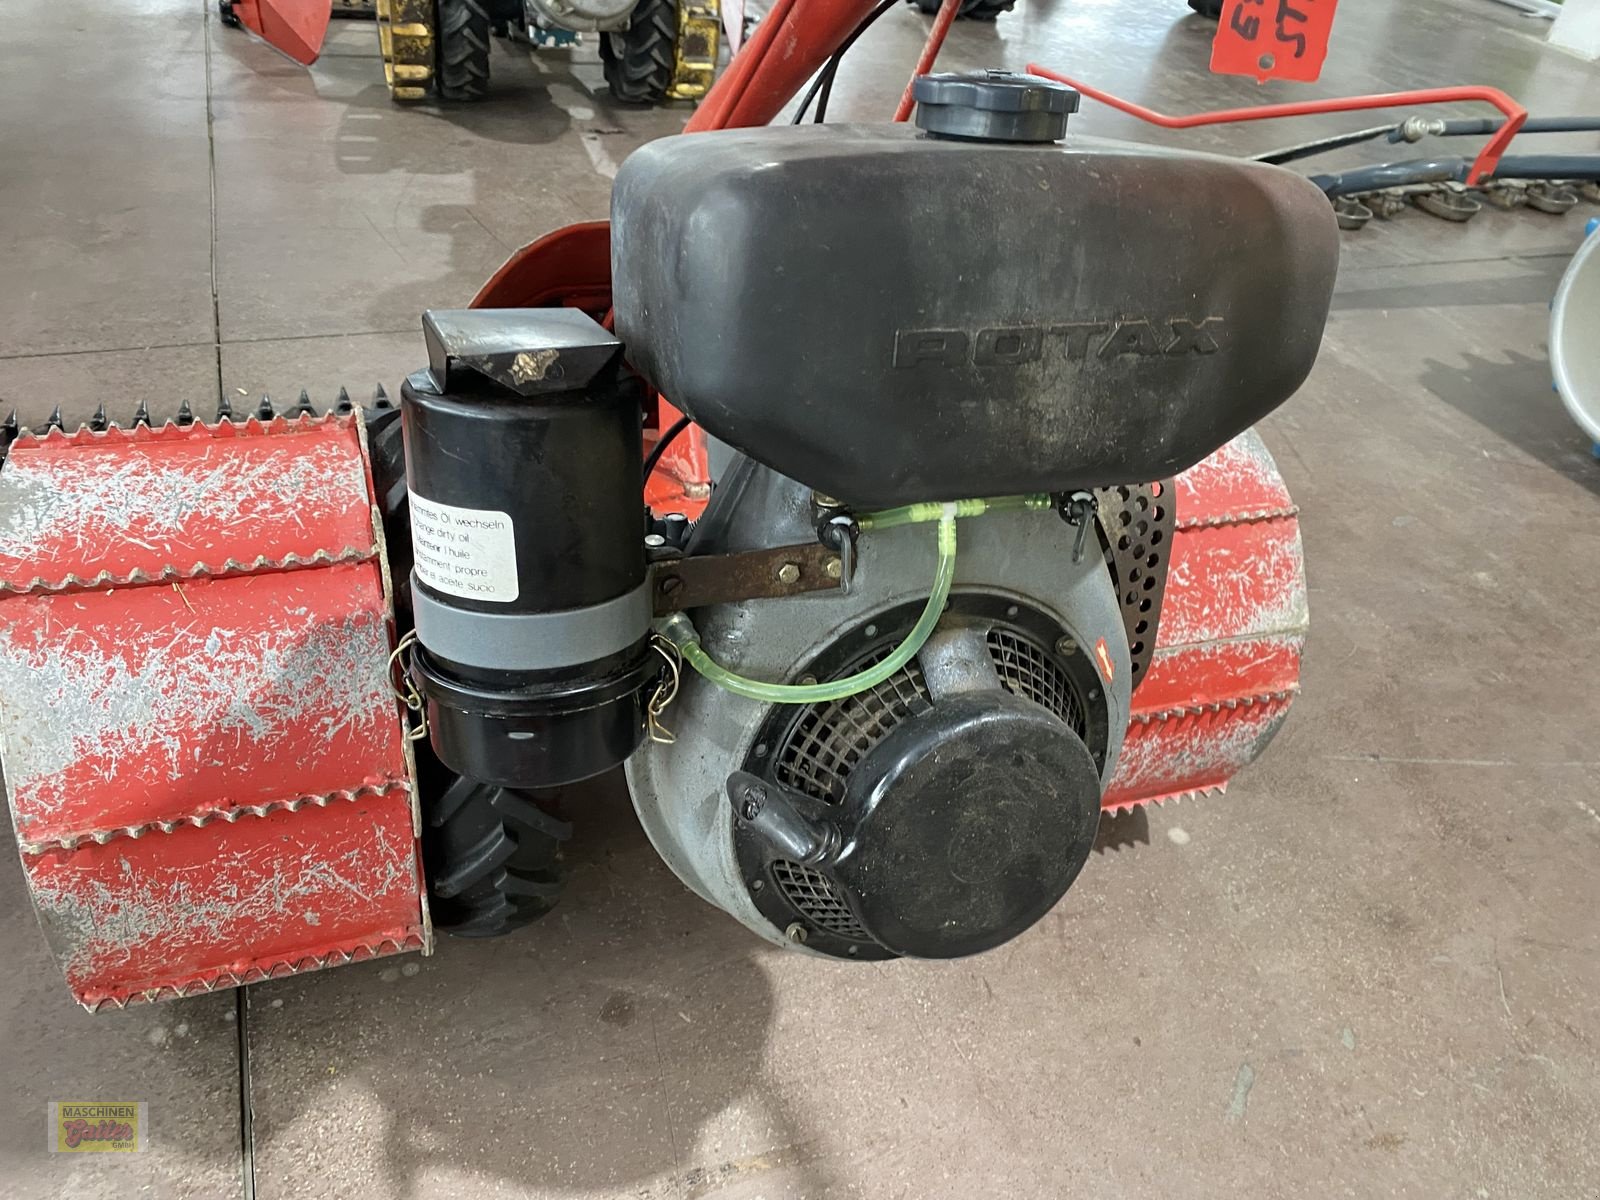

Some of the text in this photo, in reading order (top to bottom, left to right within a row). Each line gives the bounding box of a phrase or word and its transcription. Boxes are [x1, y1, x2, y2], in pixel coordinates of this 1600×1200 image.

[892, 315, 1225, 369] ROTAX
[440, 510, 451, 524] Öl
[455, 518, 505, 531] wechseln
[436, 526, 456, 543] dirty
[458, 533, 470, 543] oil
[454, 564, 488, 577] propre
[438, 575, 464, 588] aceite
[467, 581, 496, 593] sucio
